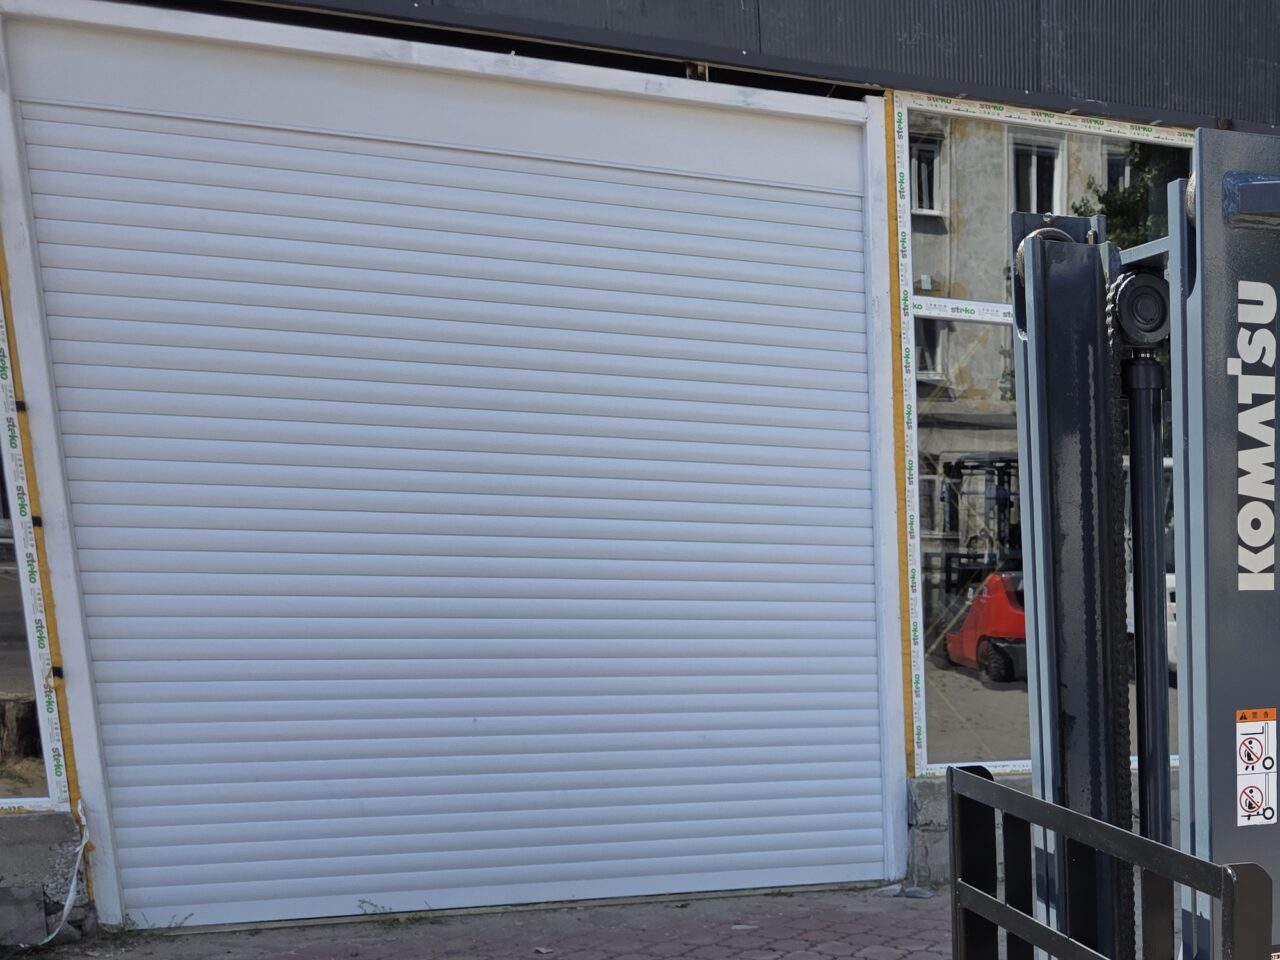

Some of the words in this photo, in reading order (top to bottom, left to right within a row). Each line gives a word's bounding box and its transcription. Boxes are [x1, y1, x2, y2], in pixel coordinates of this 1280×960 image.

[951, 306, 975, 315] steko
[1227, 280, 1277, 591] KOMATSU
[16, 485, 27, 517] steko
[25, 552, 37, 584] steko
[35, 619, 45, 649] steko
[52, 747, 62, 777] steko
